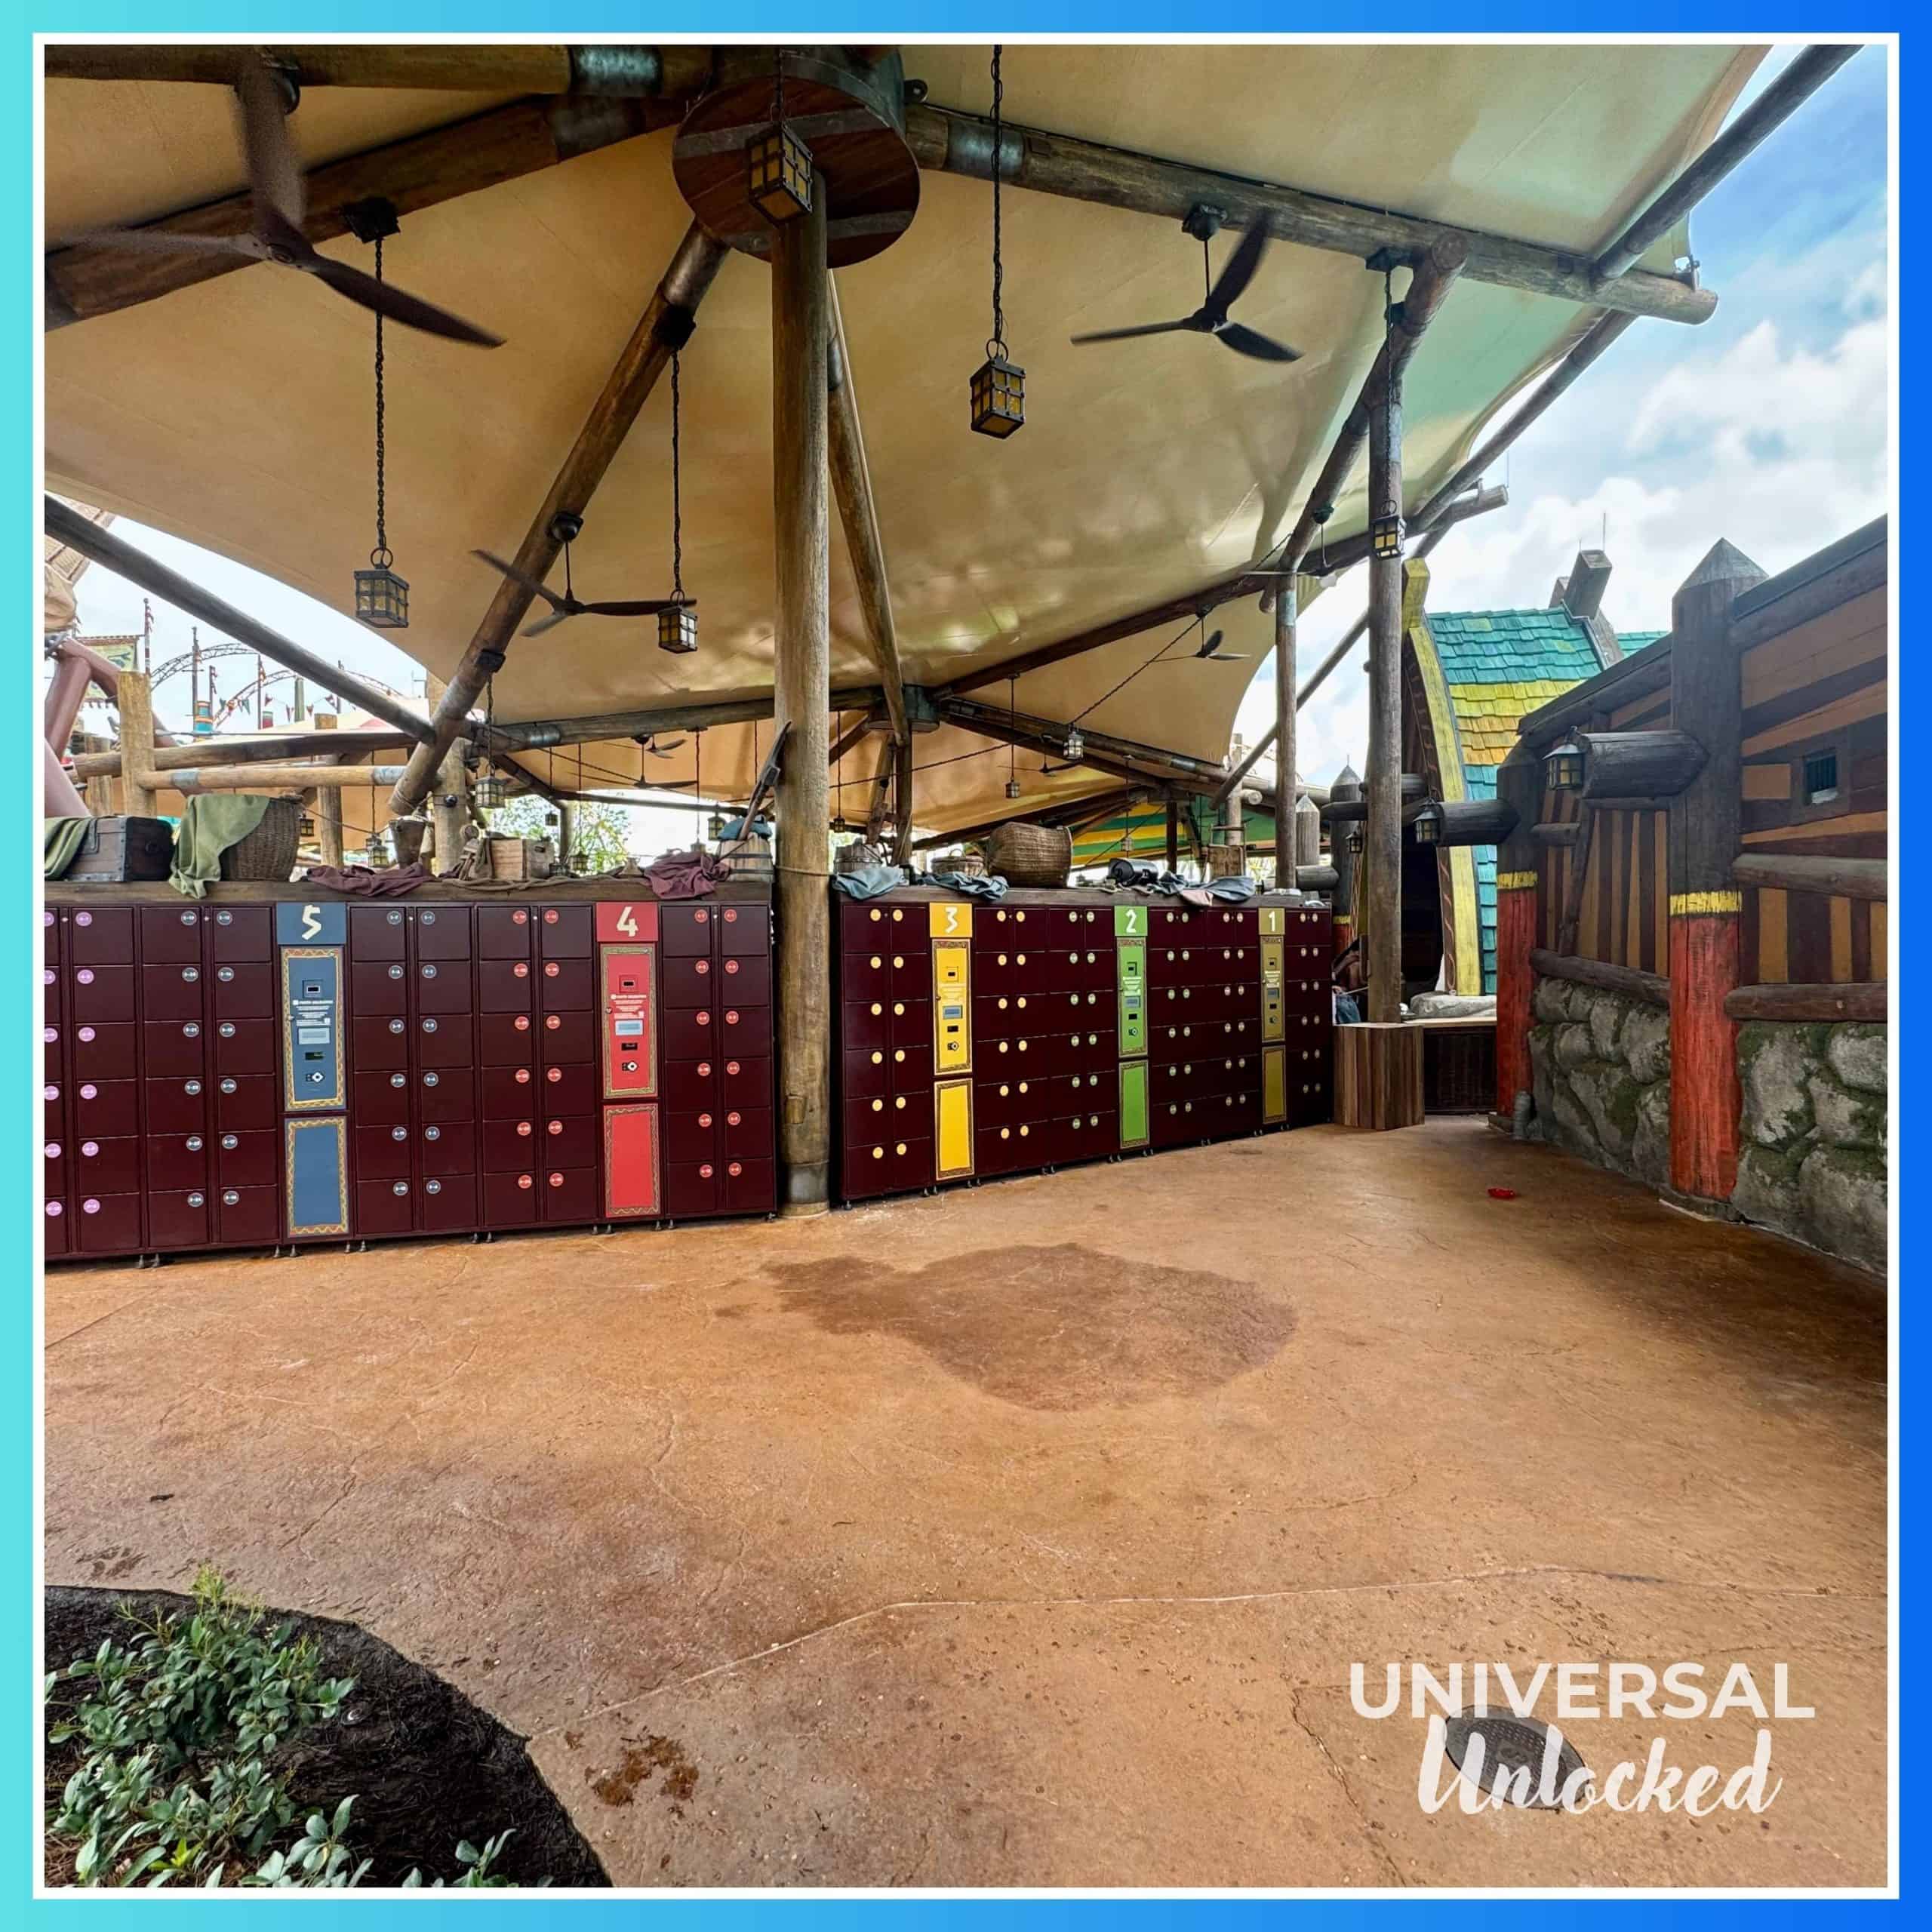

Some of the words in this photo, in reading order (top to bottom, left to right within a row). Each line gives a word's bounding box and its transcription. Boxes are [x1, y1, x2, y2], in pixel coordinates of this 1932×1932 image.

[302, 904, 321, 940] 5
[616, 906, 639, 937] 4
[945, 906, 958, 934] 3
[1125, 909, 1137, 934] 2
[1268, 911, 1275, 932] 1
